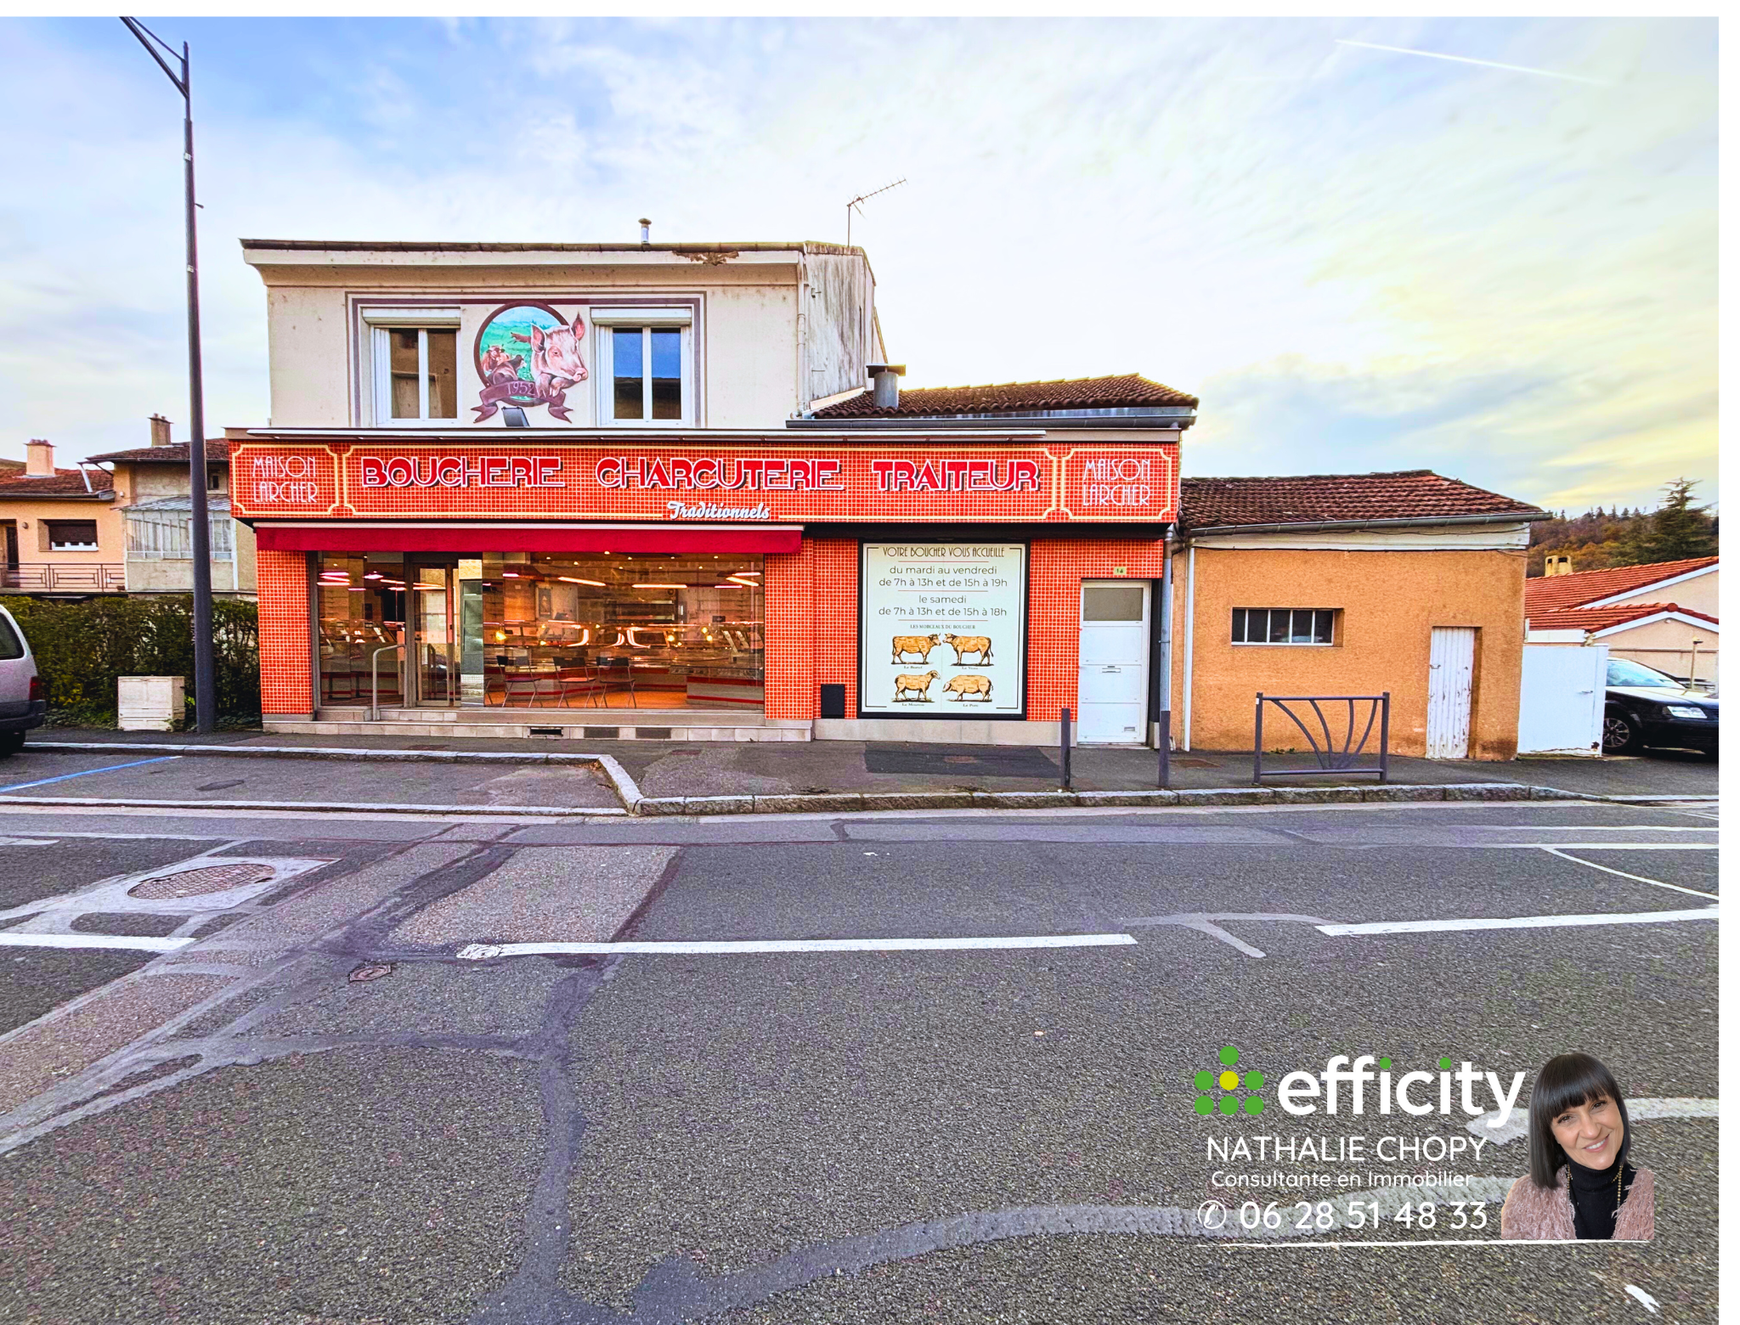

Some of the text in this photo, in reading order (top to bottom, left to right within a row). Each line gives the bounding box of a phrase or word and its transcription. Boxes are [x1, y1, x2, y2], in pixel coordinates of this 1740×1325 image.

[507, 382, 535, 395] 1952
[253, 456, 316, 477] MAISON
[361, 456, 1040, 491] BOUCHERIE CHARCUTERIE TRAITEUR
[1083, 459, 1150, 480] MAISON
[253, 482, 317, 502] LARCHER
[1083, 485, 1150, 506] LARCHER
[667, 501, 770, 519] Traditionnels
[883, 547, 1004, 557] VOTRE BOUCHER VOUS ACCUEILLE
[890, 566, 902, 574] du
[906, 566, 935, 574] mardi
[953, 566, 997, 574] vendredi
[879, 578, 891, 586] de
[894, 578, 906, 586] 7h
[909, 578, 914, 586] à
[918, 578, 933, 586] 13h
[949, 578, 961, 586] de
[992, 579, 1007, 587] 19h
[919, 595, 966, 603] le samedi
[879, 607, 891, 615] de
[894, 607, 906, 615] 7h
[909, 607, 914, 615] à
[917, 607, 932, 615] 13h
[982, 608, 987, 616] à
[990, 608, 1007, 616] 18h
